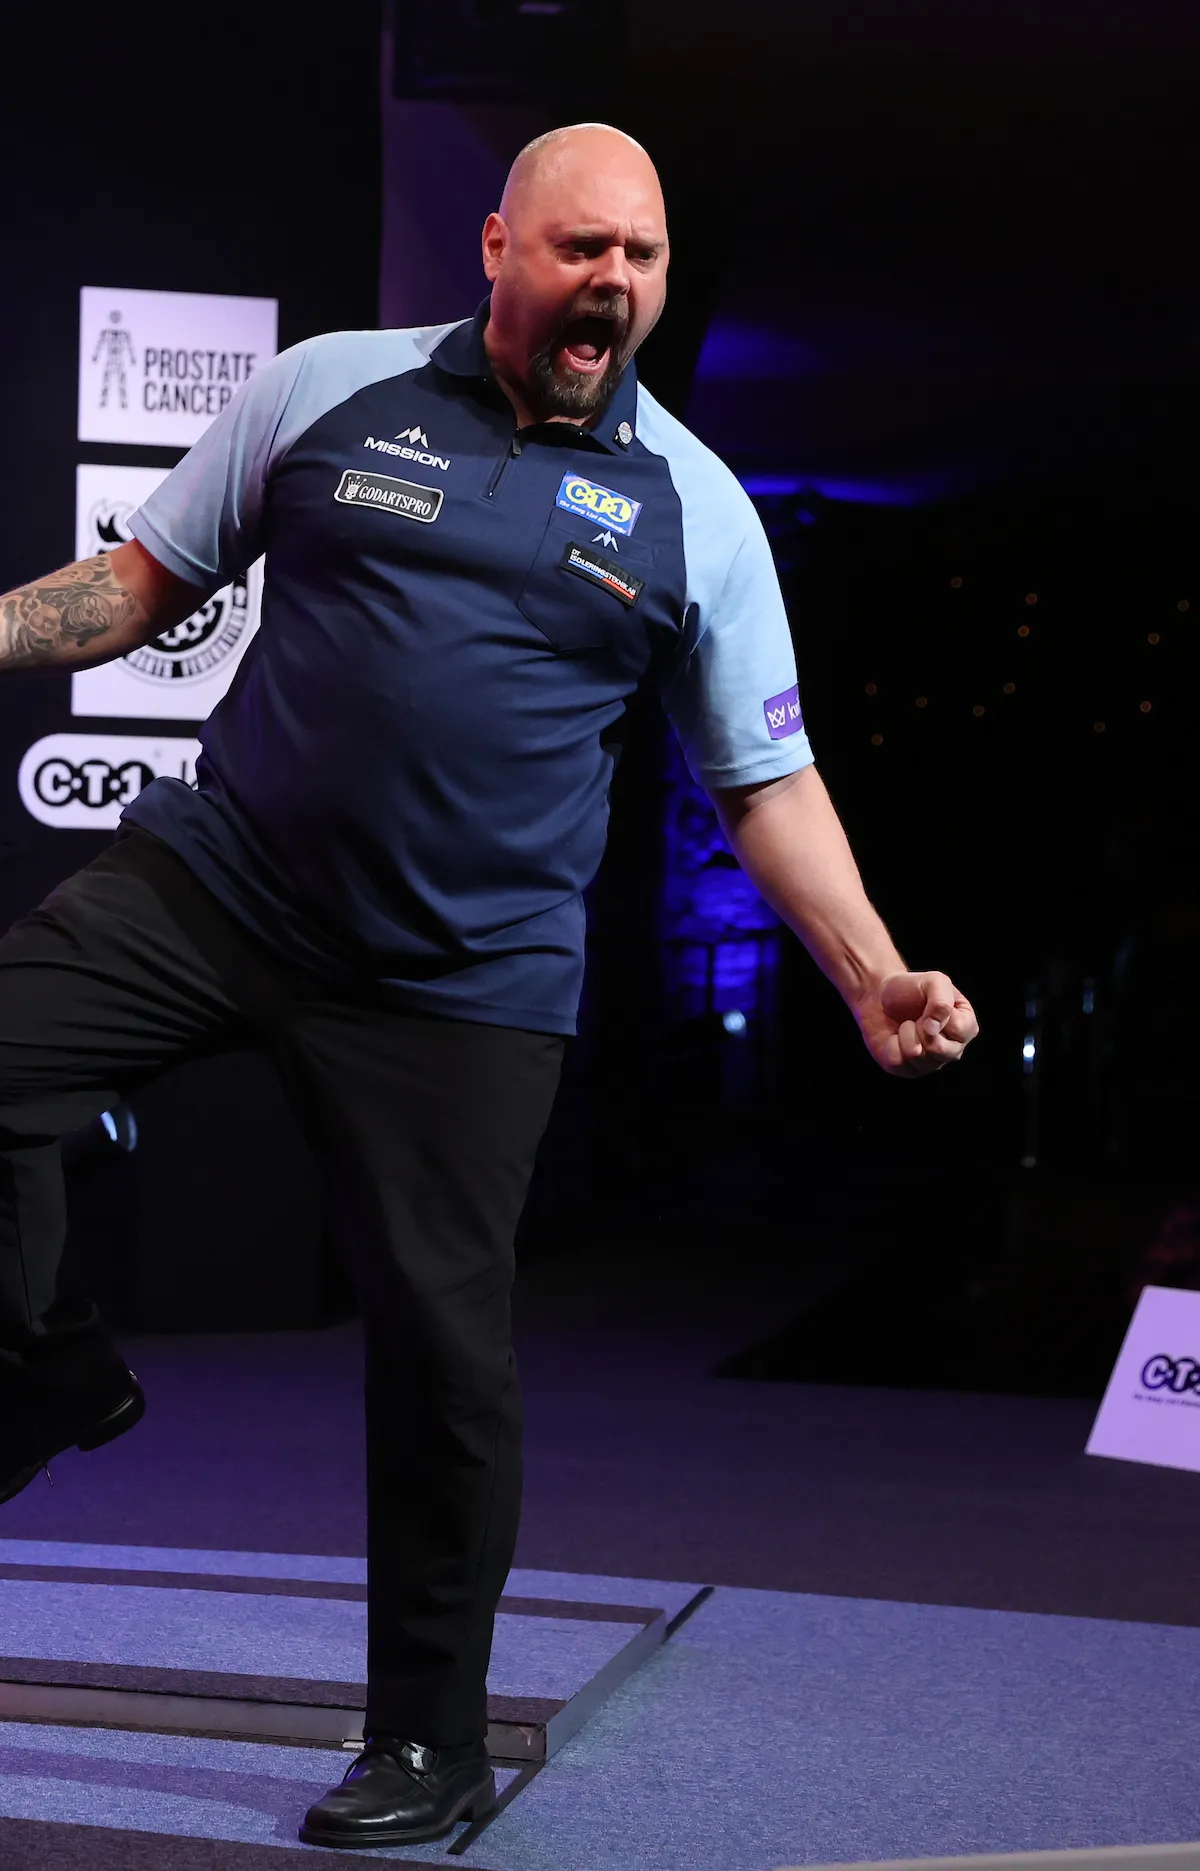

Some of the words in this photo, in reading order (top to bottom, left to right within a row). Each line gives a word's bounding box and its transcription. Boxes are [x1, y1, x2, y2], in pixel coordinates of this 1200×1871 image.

[144, 347, 257, 381] PROSTATE
[363, 436, 451, 471] MISSION
[359, 485, 431, 516] GODARTSPRO
